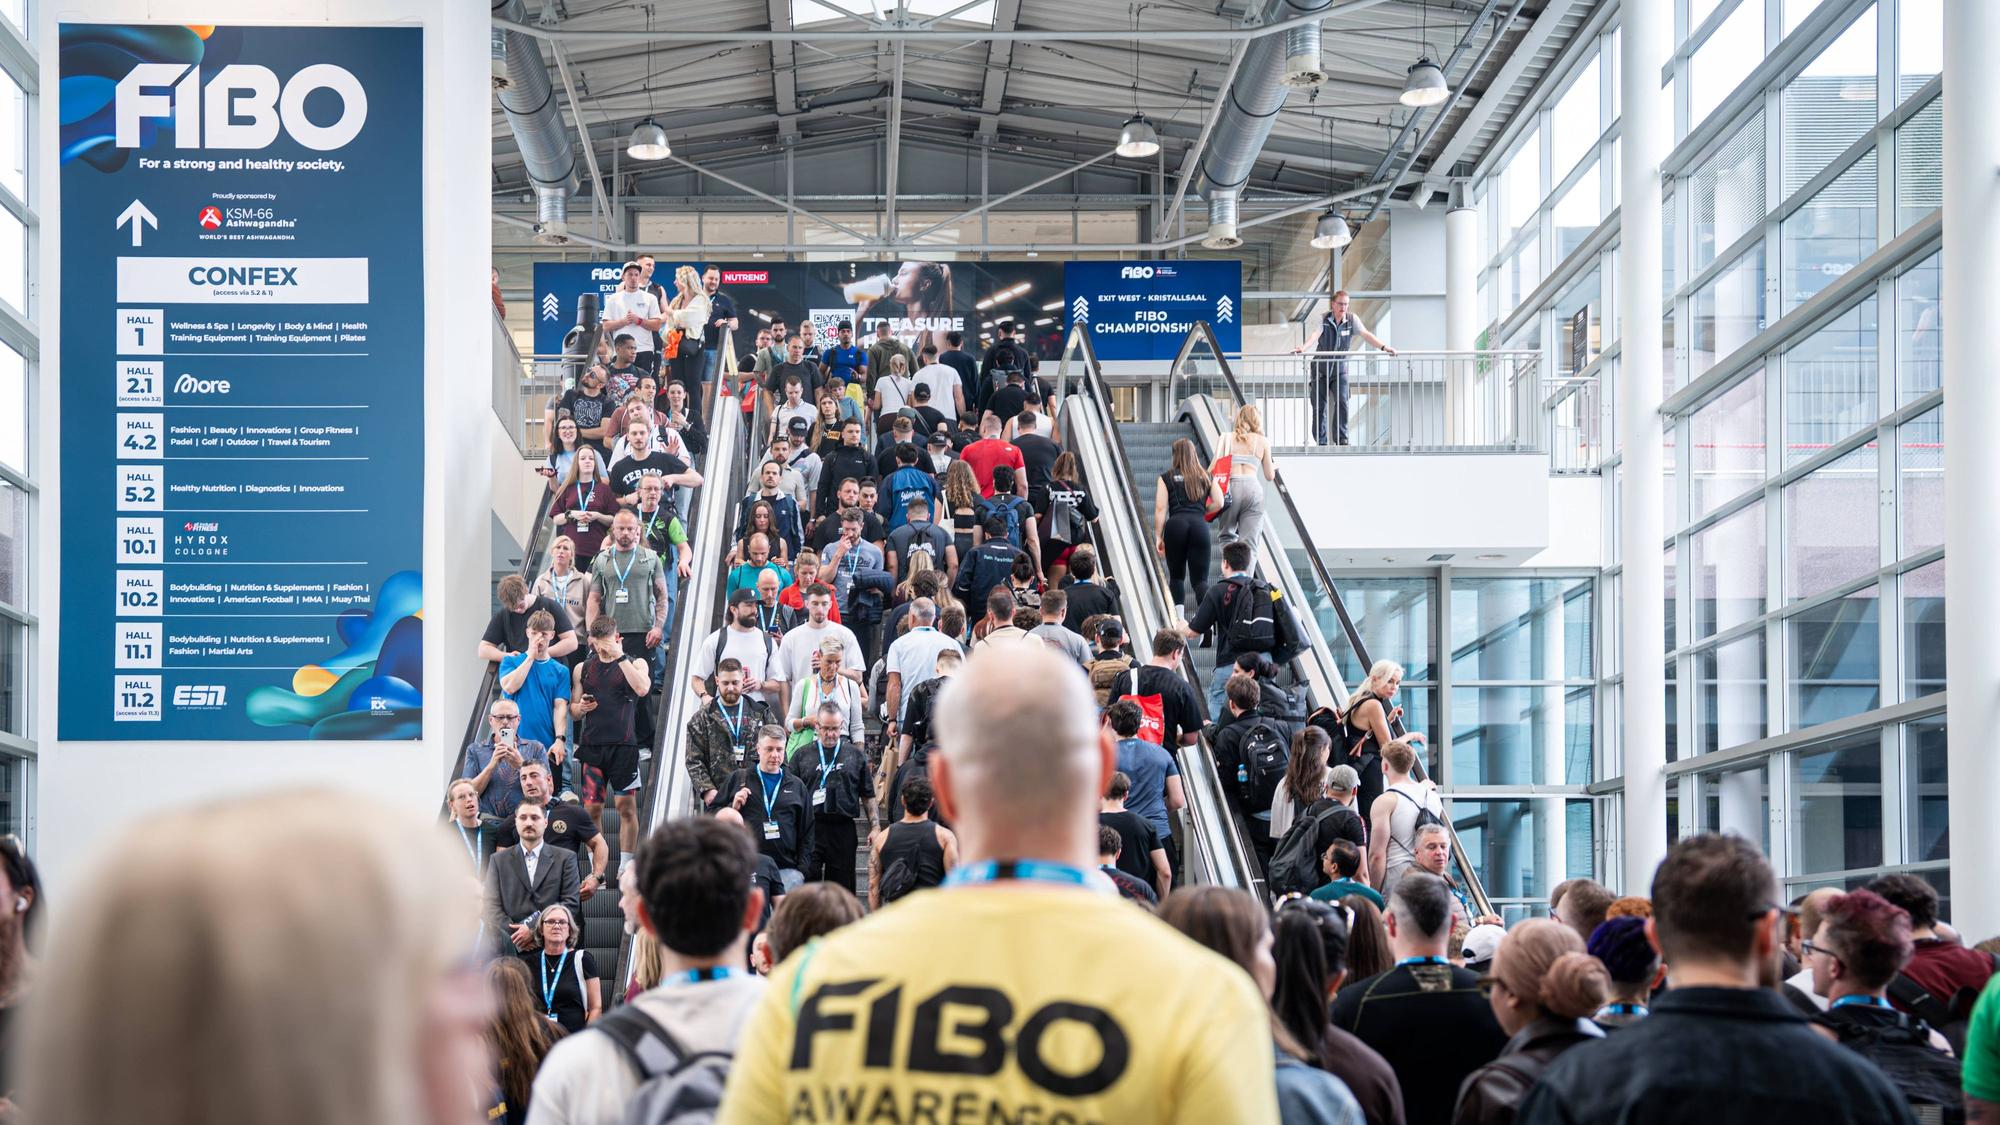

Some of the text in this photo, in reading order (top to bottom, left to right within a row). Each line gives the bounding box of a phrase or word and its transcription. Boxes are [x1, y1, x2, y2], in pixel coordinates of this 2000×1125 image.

[116, 63, 367, 150] FIBO
[139, 158, 160, 168] For
[174, 159, 216, 171] strong
[218, 158, 243, 169] and
[245, 159, 294, 172] healthy
[297, 159, 345, 172] society.
[226, 208, 273, 219] KSM-66
[188, 266, 298, 286] CONFEX
[592, 268, 622, 280] FIBO
[724, 273, 766, 281] NUTREND
[1122, 266, 1154, 279] FIBO
[127, 316, 154, 324] HALL
[1135, 311, 1168, 321] FIBO
[214, 322, 229, 331] Spa
[238, 322, 276, 331] Longevity
[284, 323, 305, 331] Body
[134, 328, 144, 346] 1
[170, 334, 202, 342] Training
[204, 334, 247, 342] Equipment
[256, 334, 287, 343] Training
[289, 334, 331, 343] Equipment
[127, 378, 152, 393] 2.1
[174, 374, 230, 394] More
[210, 426, 237, 435] Beauty
[300, 427, 324, 435] Group
[124, 435, 156, 450] 4.2
[125, 486, 156, 502] 5.2
[170, 485, 200, 493] Healthy
[245, 485, 290, 493] Diagnostics
[123, 539, 156, 554] 10.1
[175, 536, 228, 544] HYROX
[170, 584, 221, 592] Bodybuilding
[273, 584, 324, 592] Supplements
[120, 592, 158, 607] 10.2
[332, 596, 352, 604] Muay
[169, 636, 221, 644] Bodybuilding
[273, 636, 324, 644] Supplements
[124, 645, 152, 660] 11.1
[122, 693, 154, 707] 11.2
[790, 978, 1130, 1097] FIBO
